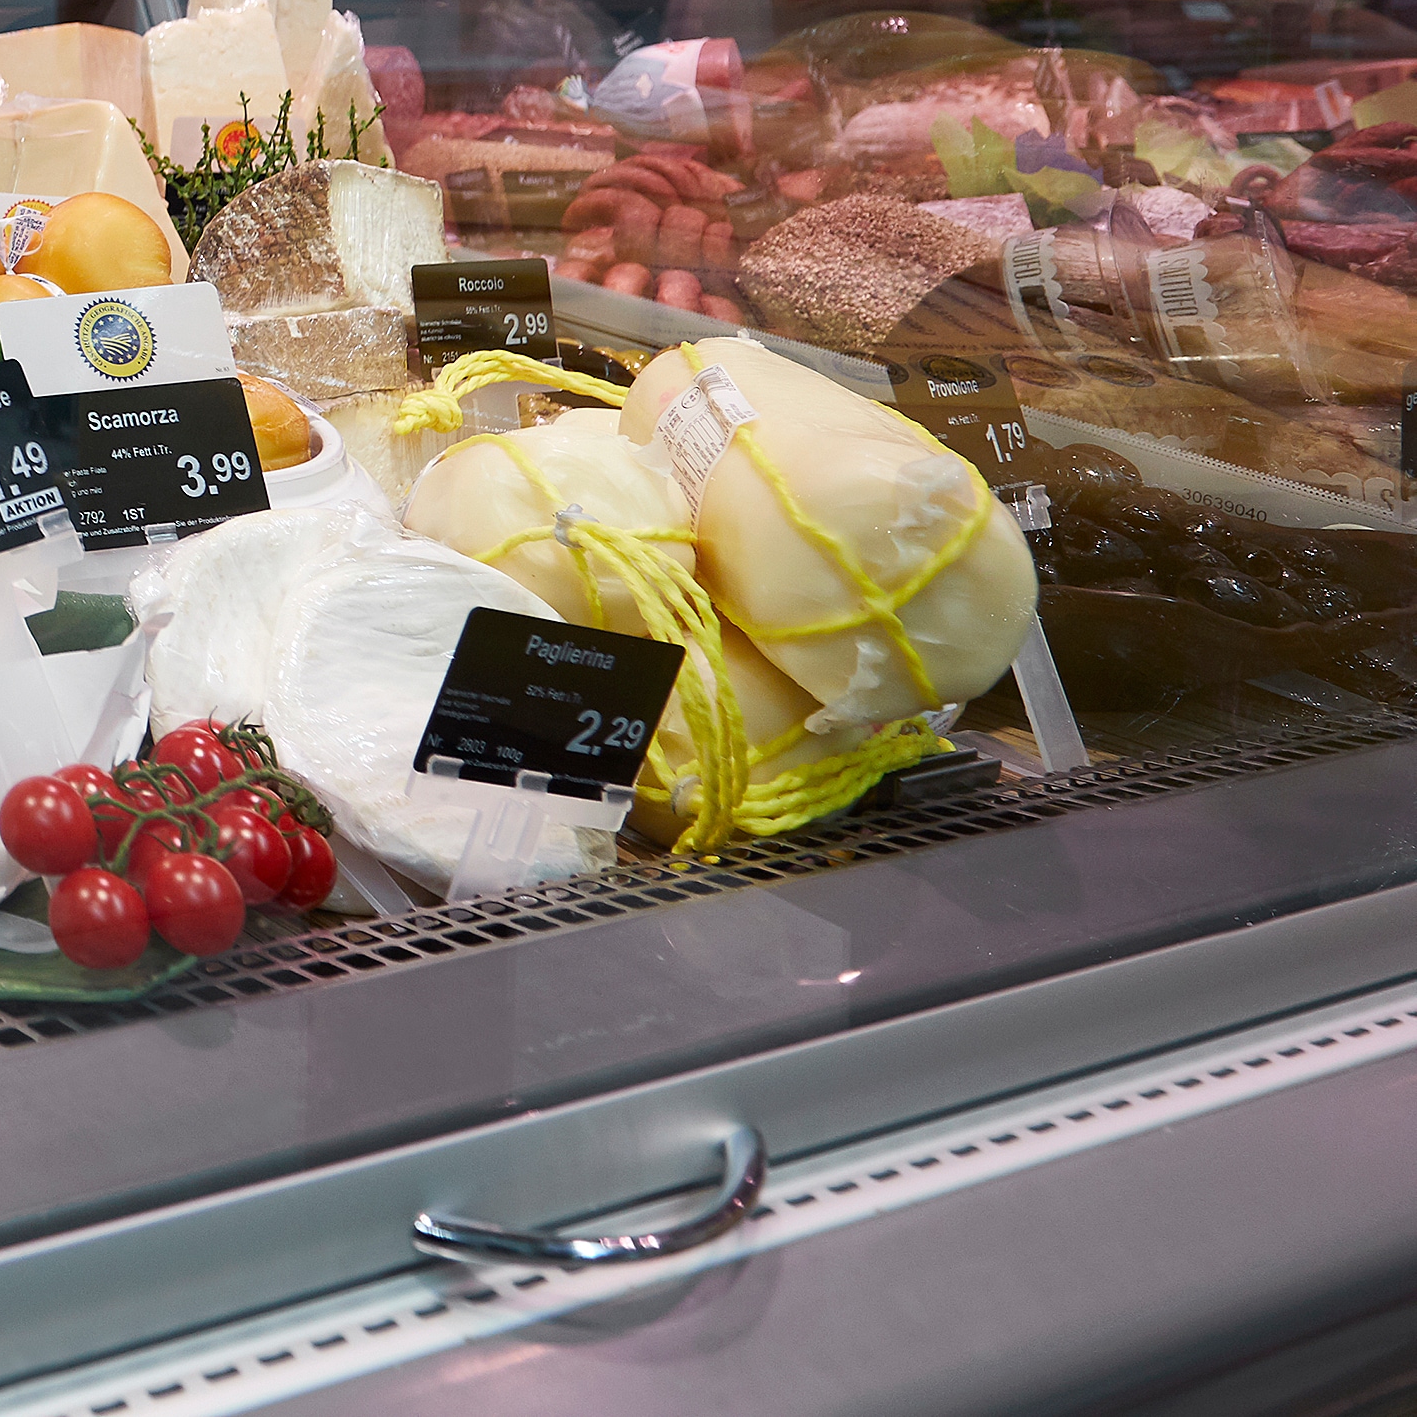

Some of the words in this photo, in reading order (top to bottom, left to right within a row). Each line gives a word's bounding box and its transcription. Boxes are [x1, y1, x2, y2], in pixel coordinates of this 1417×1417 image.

[459, 276, 504, 292] Roccolo
[504, 313, 548, 345] 2.99
[927, 377, 979, 398] Provolone
[88, 408, 179, 431] Scamorza
[112, 449, 131, 459] 44%
[133, 447, 152, 457] Fett
[986, 422, 1025, 463] 1.79
[177, 451, 251, 498] 3.99
[6, 491, 57, 518] AKTION
[122, 508, 145, 521] 1ST
[1181, 487, 1269, 524] 30639040
[526, 634, 615, 670] Paglierina
[425, 733, 444, 748] Nr.
[566, 710, 646, 757] 2.29
